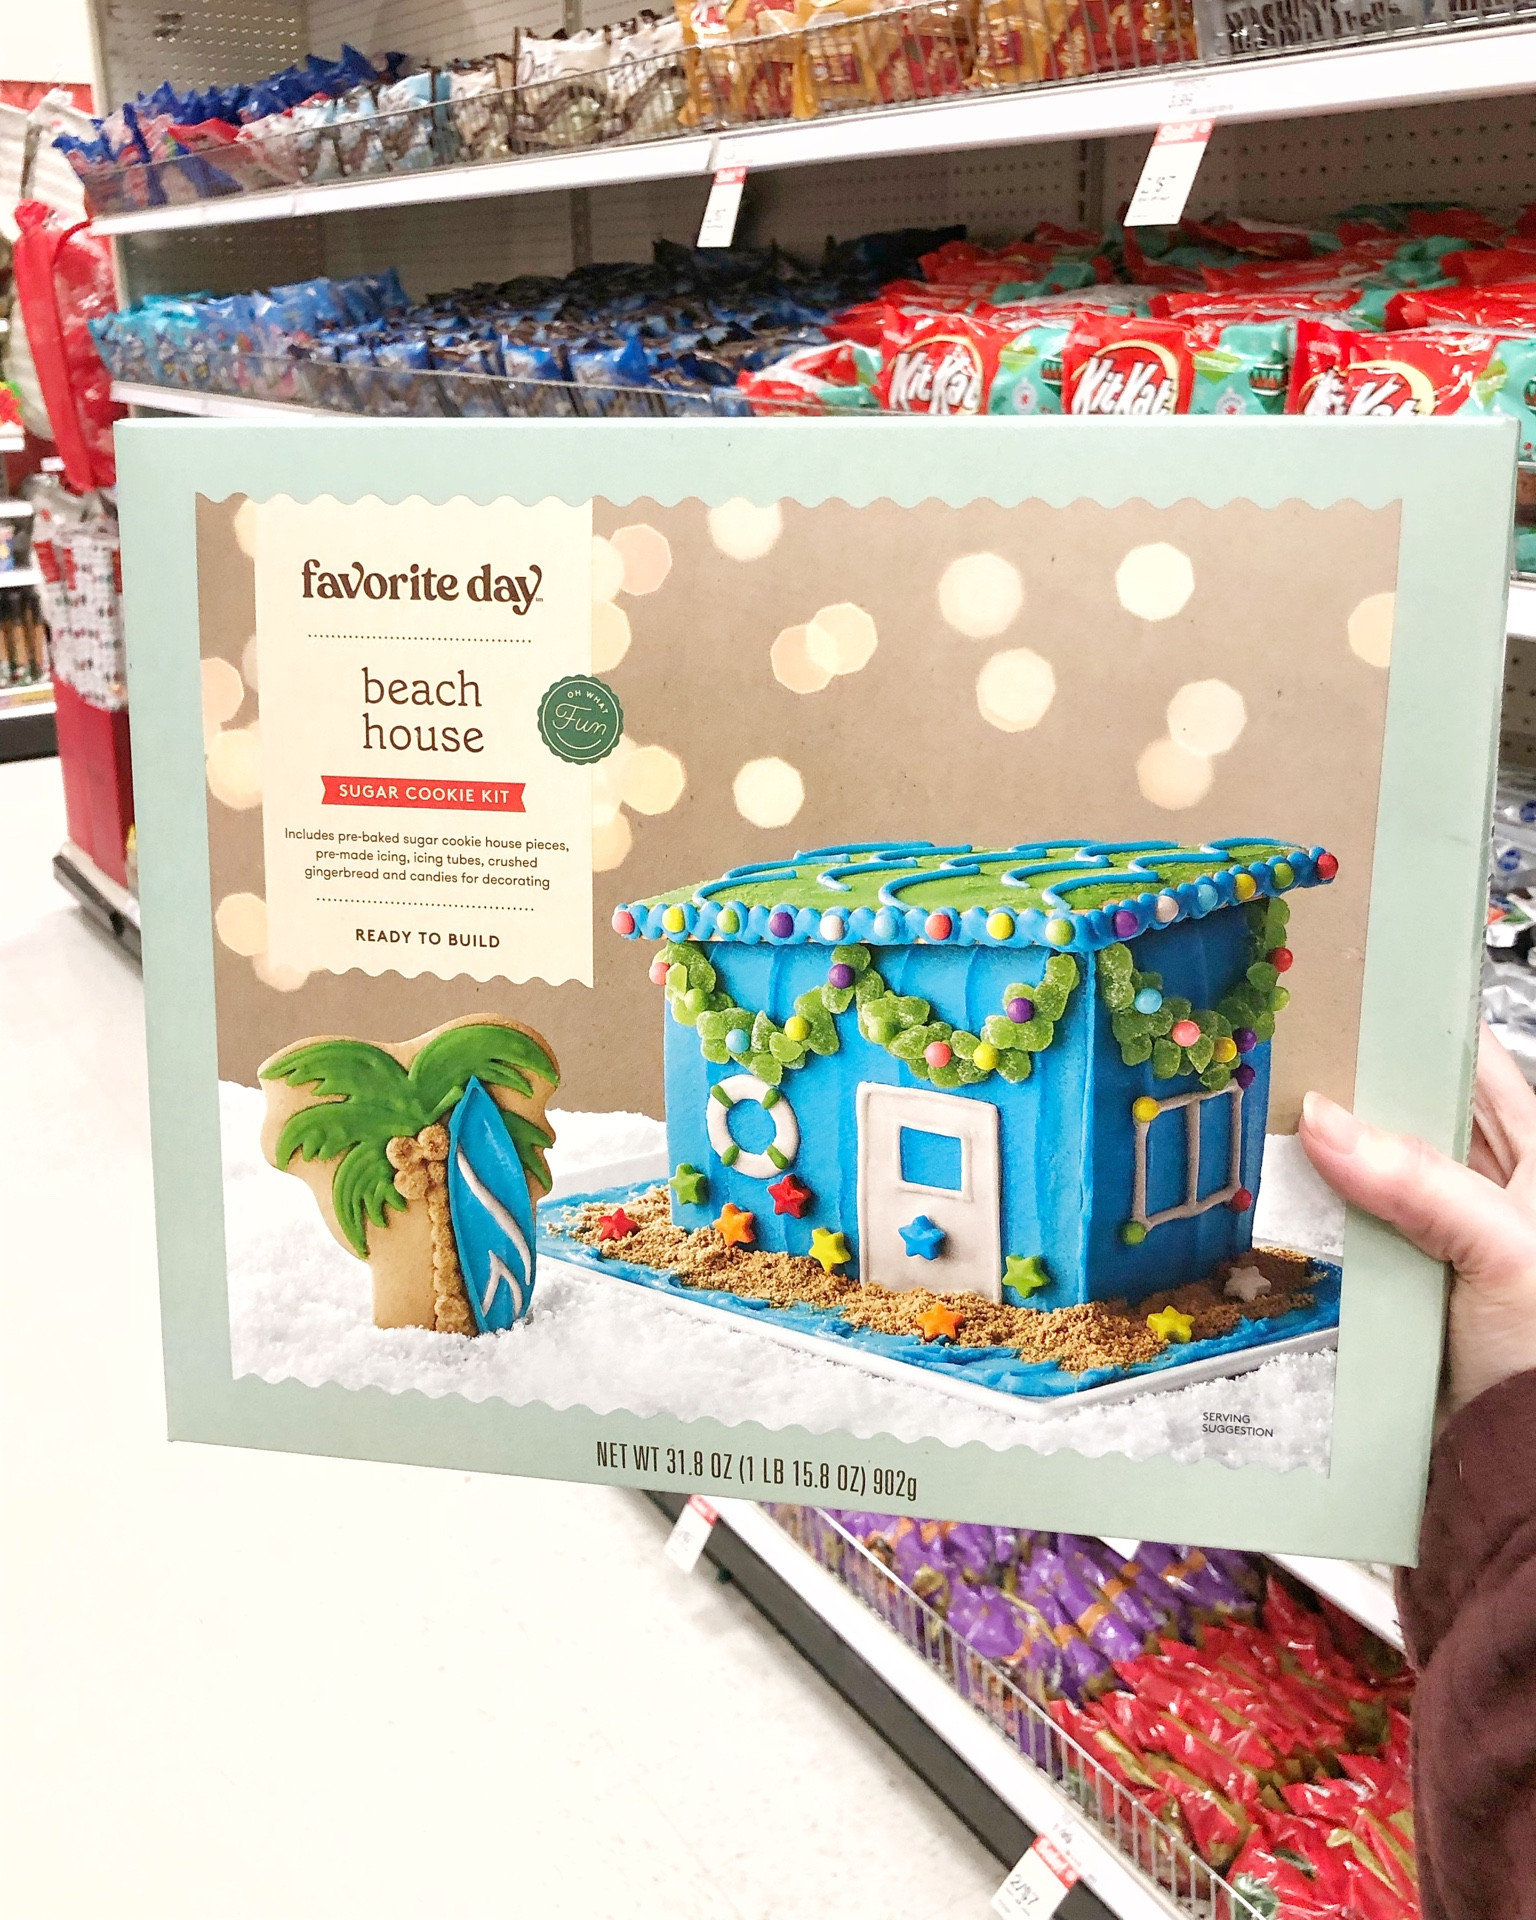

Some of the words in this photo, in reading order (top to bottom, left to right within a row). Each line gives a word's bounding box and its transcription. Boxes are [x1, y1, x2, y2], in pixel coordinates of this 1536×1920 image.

[301, 558, 459, 601] favorite
[466, 563, 542, 616] day
[361, 666, 482, 707] beach
[567, 690, 581, 698] OH
[586, 690, 608, 714] WHAT
[552, 703, 607, 736] Fun
[362, 712, 484, 753] house
[339, 784, 399, 799] SUGAR
[405, 786, 475, 803] COOKIE
[481, 789, 510, 804] KIT
[284, 827, 335, 841] Includes
[338, 831, 400, 844] pre-baked
[403, 836, 438, 848] sugar
[442, 835, 482, 847] cookie
[485, 836, 522, 849] house
[526, 838, 569, 852] pieces,
[316, 850, 374, 861] pre-made
[377, 850, 410, 865] icing,
[413, 852, 443, 867] icing
[447, 854, 485, 867] tubes,
[488, 856, 538, 868] crushed
[304, 866, 379, 880] gingerbread
[382, 870, 407, 881] and
[410, 871, 458, 883] candies
[461, 872, 479, 884] for
[482, 874, 550, 890] decorating
[355, 928, 412, 943] READY
[418, 932, 441, 945] TO
[448, 933, 500, 948] BUILD
[1202, 1412, 1251, 1424] SERVING
[1202, 1423, 1274, 1437] SUGGESTION
[596, 1441, 628, 1469] NET
[633, 1445, 660, 1473] WT
[666, 1448, 704, 1477] 31.8
[711, 1452, 733, 1480] OZ
[739, 1455, 754, 1484] (1
[763, 1457, 784, 1485] LB
[792, 1460, 830, 1489] 15.8
[837, 1464, 867, 1496] OZ)
[873, 1468, 917, 1501] 902g
